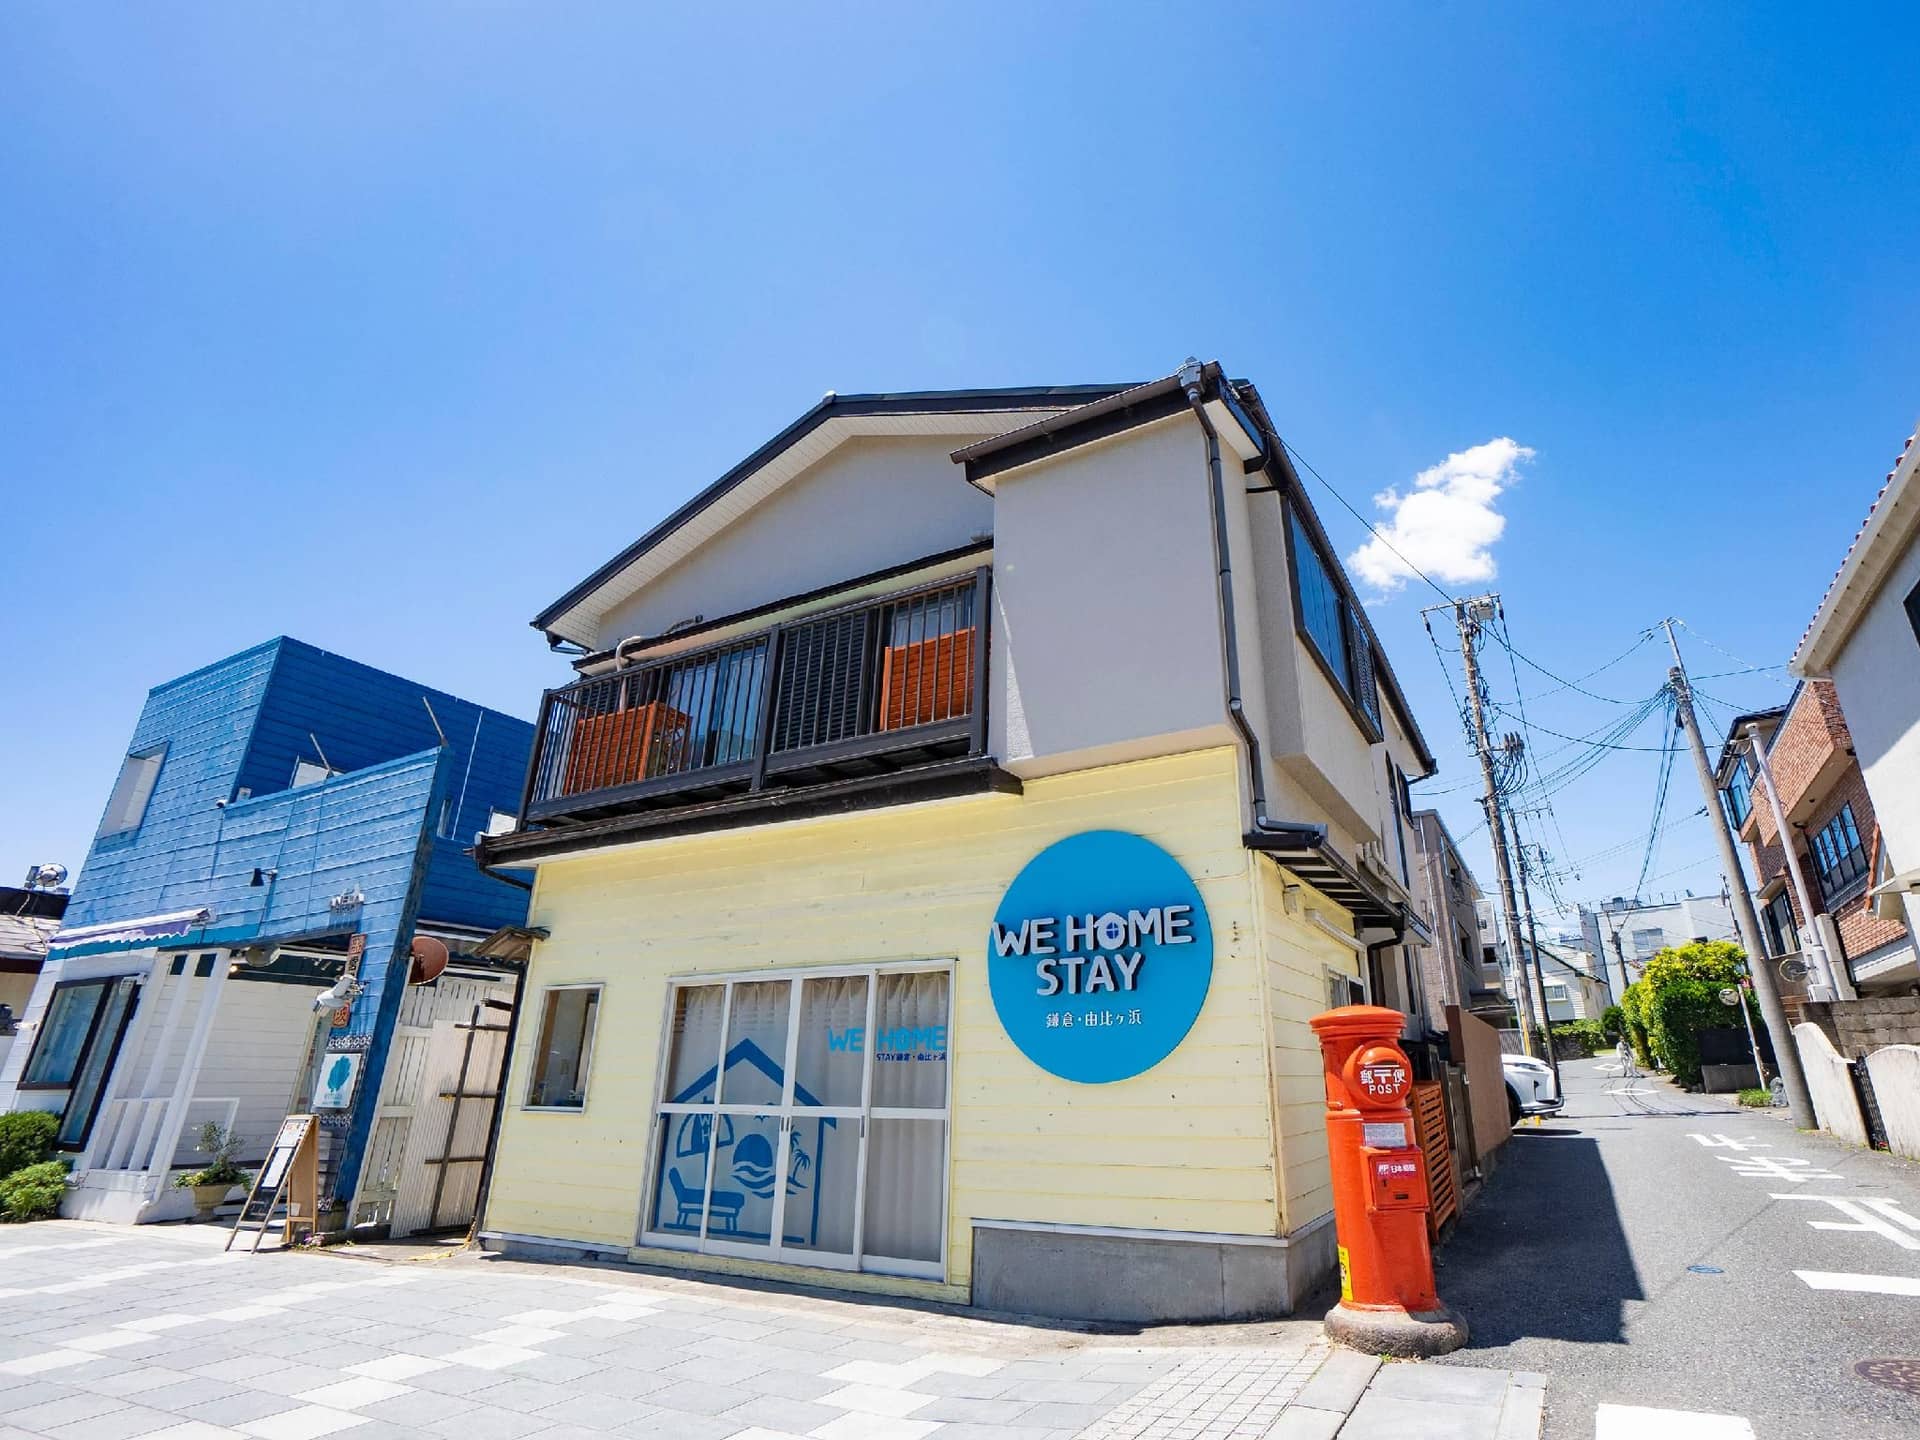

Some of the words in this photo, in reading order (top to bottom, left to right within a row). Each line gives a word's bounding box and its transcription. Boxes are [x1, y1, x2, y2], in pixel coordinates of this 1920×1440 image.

[991, 917, 1057, 956] WE
[1066, 904, 1193, 952] HOME
[1036, 951, 1143, 996] STAY
[827, 1027, 865, 1053] WE
[876, 1025, 946, 1051] HOME
[1368, 1083, 1401, 1095] POST
